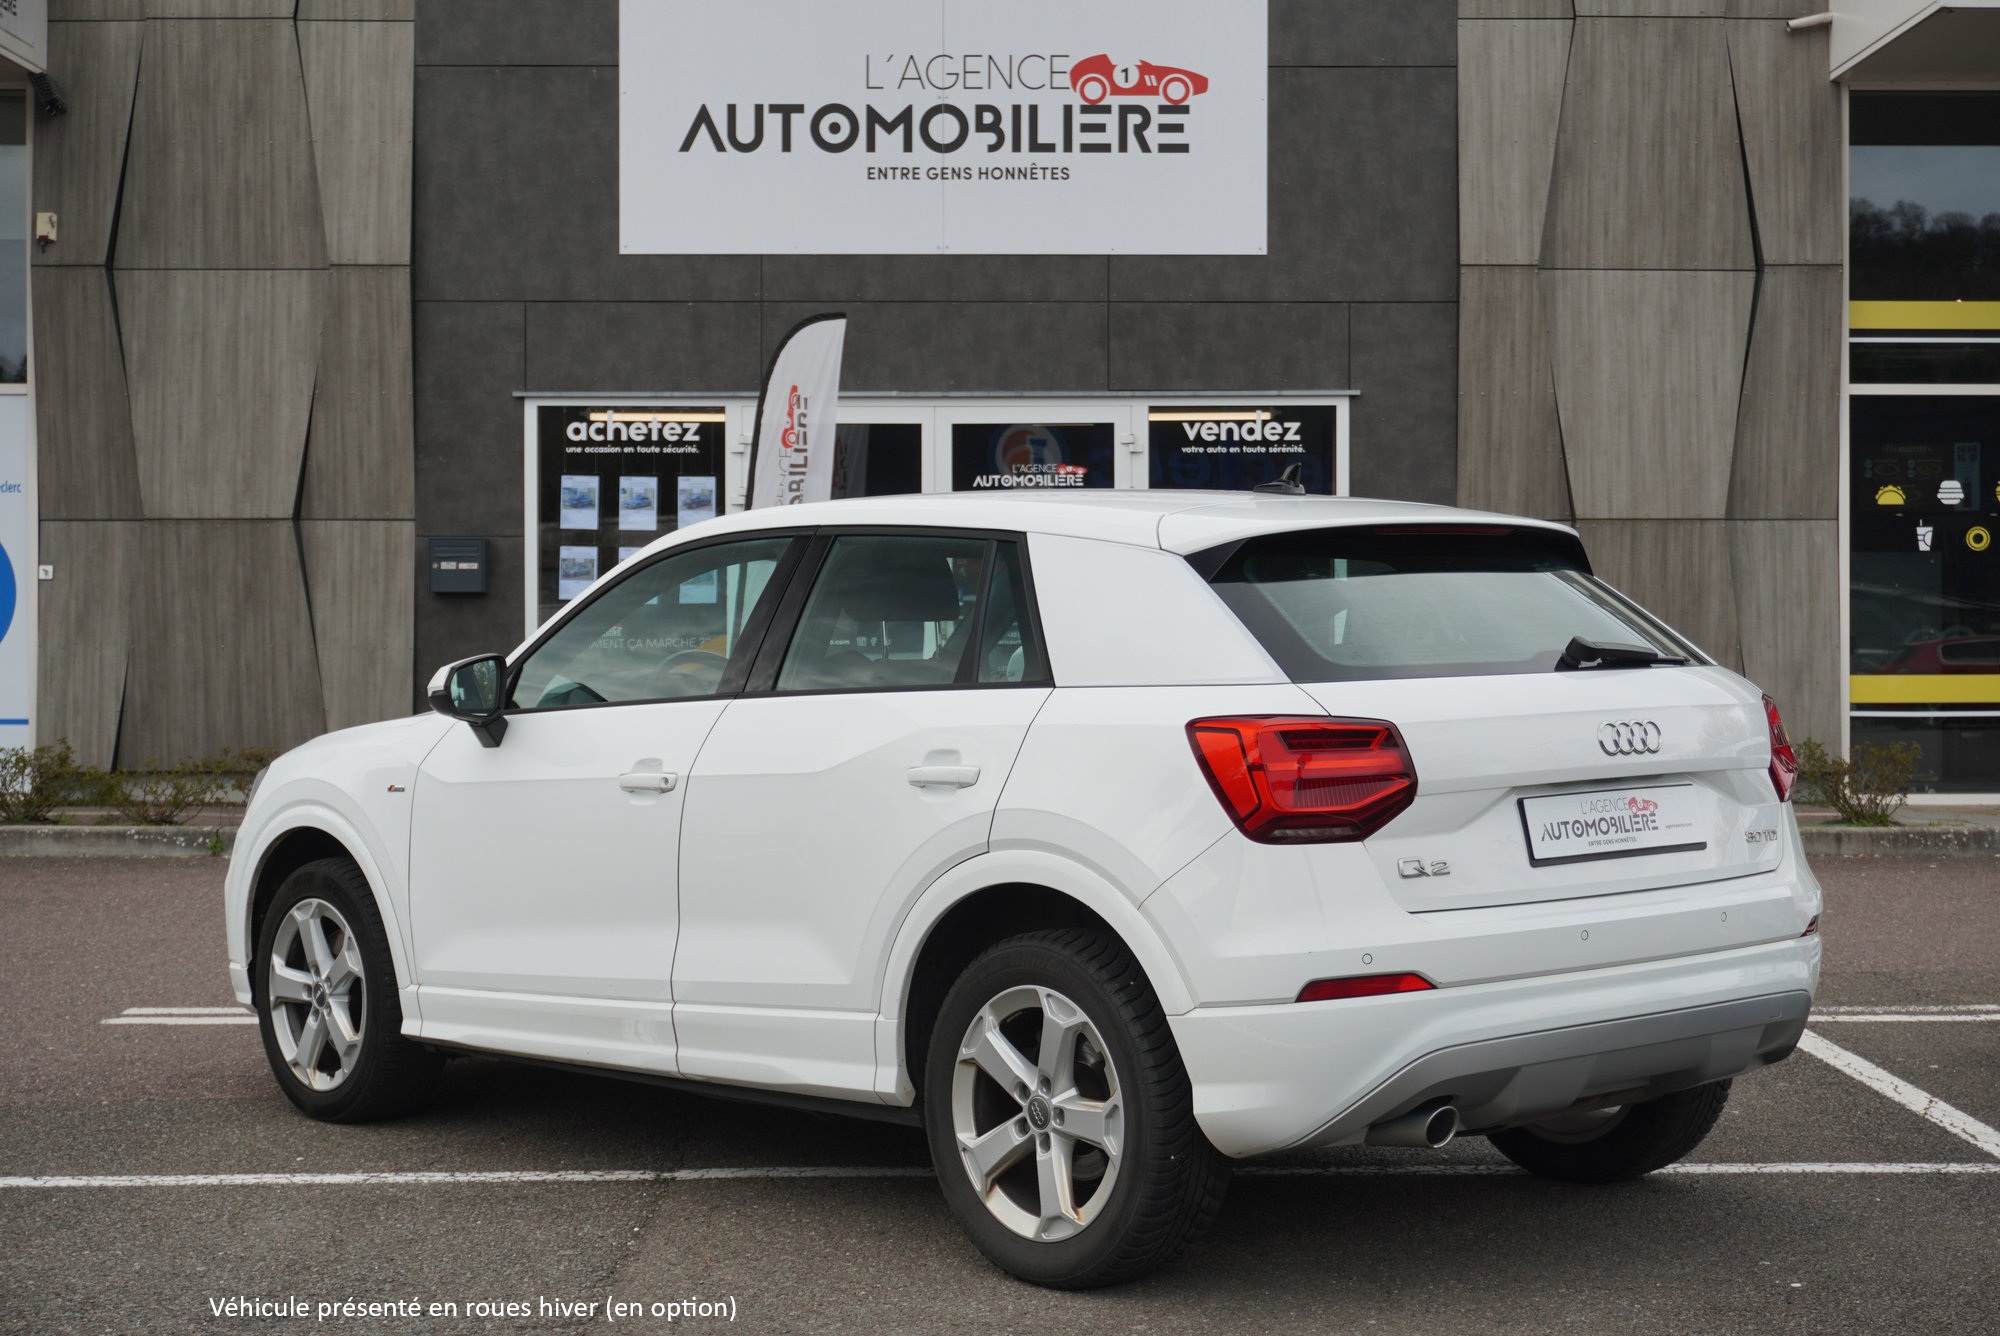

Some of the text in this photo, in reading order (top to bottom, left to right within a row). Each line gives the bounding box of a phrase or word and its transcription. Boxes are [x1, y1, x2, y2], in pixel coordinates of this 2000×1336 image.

[865, 53, 1071, 90] L'AGENCE
[1120, 67, 1130, 84] 1
[867, 162, 1070, 181] ENTRE GENS HONNÊTES
[566, 410, 701, 442] achetez
[1181, 409, 1302, 442] vendez
[566, 444, 700, 454] une occasion en toute sécurité.
[1181, 443, 1307, 454] votre auto en toute sérénité.
[1012, 464, 1058, 474] L'AGENCE
[0, 480, 22, 494] clerc
[588, 638, 625, 649] MENT
[627, 638, 644, 651] ÇA
[646, 637, 697, 649] MARCHE
[1580, 797, 1629, 815] L'AGENCE
[1397, 857, 1451, 880] Q2
